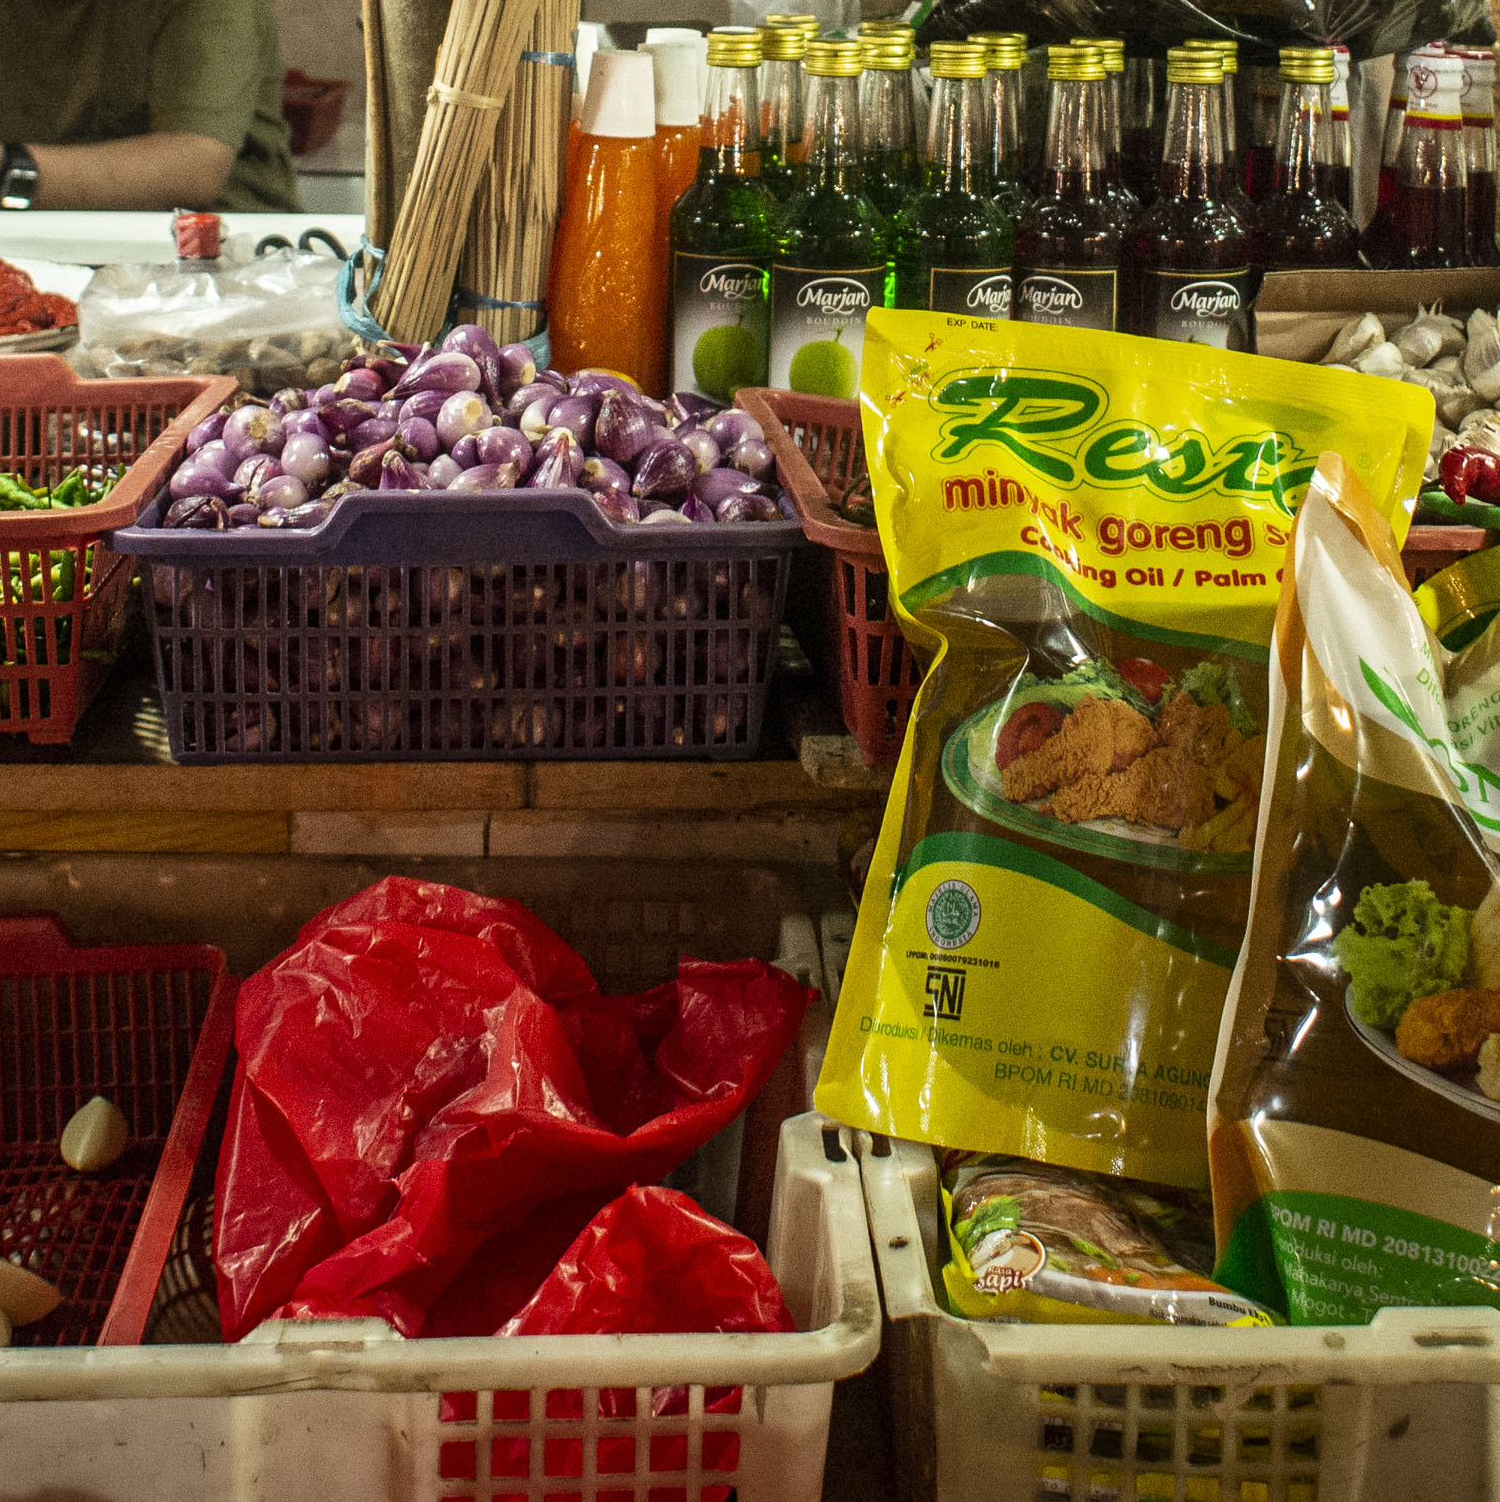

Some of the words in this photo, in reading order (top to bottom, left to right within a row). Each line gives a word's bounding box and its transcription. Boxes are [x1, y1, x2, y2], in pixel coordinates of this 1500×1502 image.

[802, 284, 868, 313] Marjan
[1021, 284, 1079, 314] Marjan
[1180, 289, 1240, 318] Marjan
[806, 316, 862, 326] BOUDOIN
[942, 470, 1085, 544] minyak
[1099, 507, 1255, 559] goreng
[1020, 525, 1118, 590] Cooking
[1131, 564, 1166, 589] Oil
[1195, 568, 1266, 589] Palm
[924, 969, 967, 1021] SNI
[927, 1026, 993, 1052] Dikemas
[998, 1039, 1033, 1059] oleh
[1049, 1045, 1079, 1067] CV.
[993, 1062, 1052, 1086] BPOM
[1057, 1071, 1077, 1092] RI
[1315, 1217, 1337, 1239] RI
[1340, 1222, 1378, 1250] MD
[1208, 1295, 1247, 1315] Bumbu
